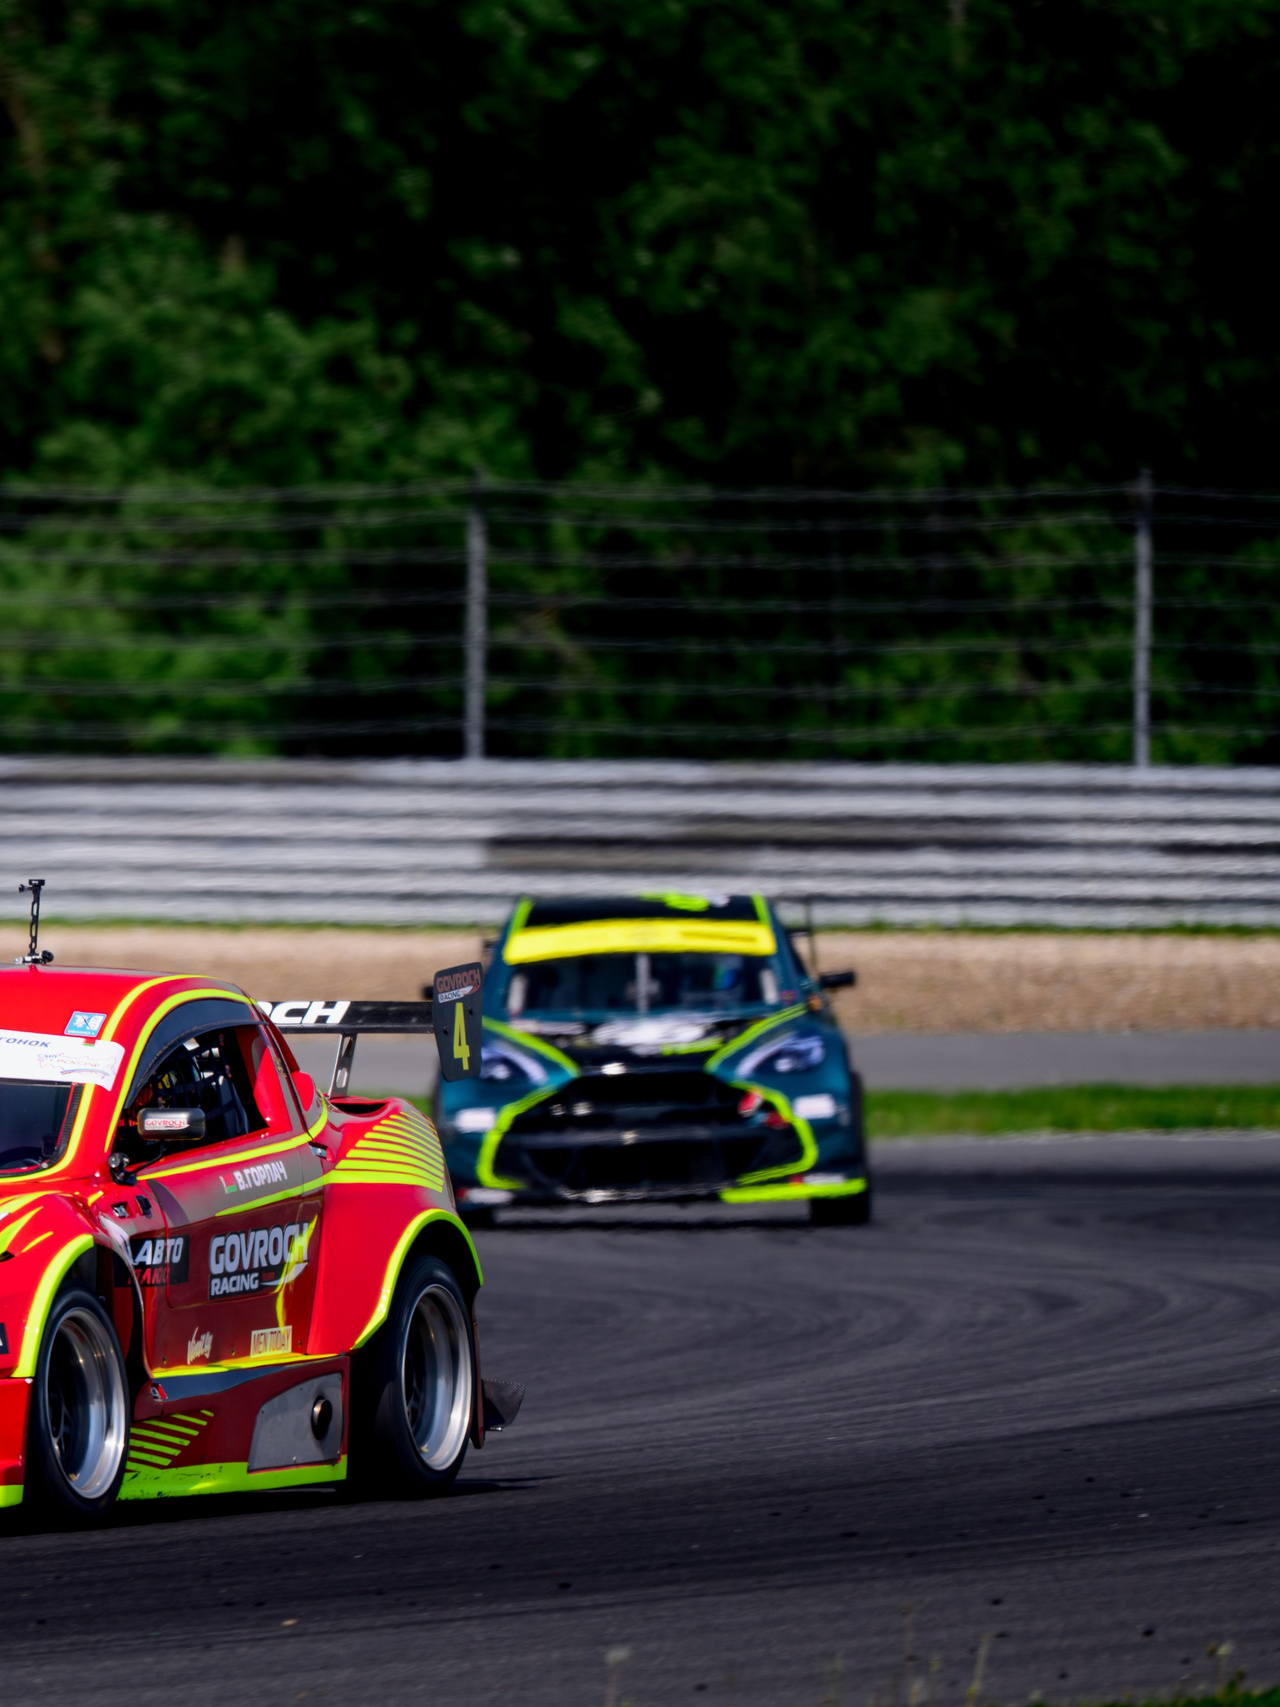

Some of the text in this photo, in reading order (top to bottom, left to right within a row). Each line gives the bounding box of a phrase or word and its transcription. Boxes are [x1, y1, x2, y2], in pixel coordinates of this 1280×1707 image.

[436, 968, 480, 993] GOVROCH
[440, 989, 461, 1001] RACING
[453, 1002, 470, 1070] 4
[233, 1160, 288, 1191] В.ГОРЛАЧ
[133, 1237, 184, 1265] АВТО
[209, 1222, 309, 1275] GOVROCH
[211, 1272, 260, 1297] RACING
